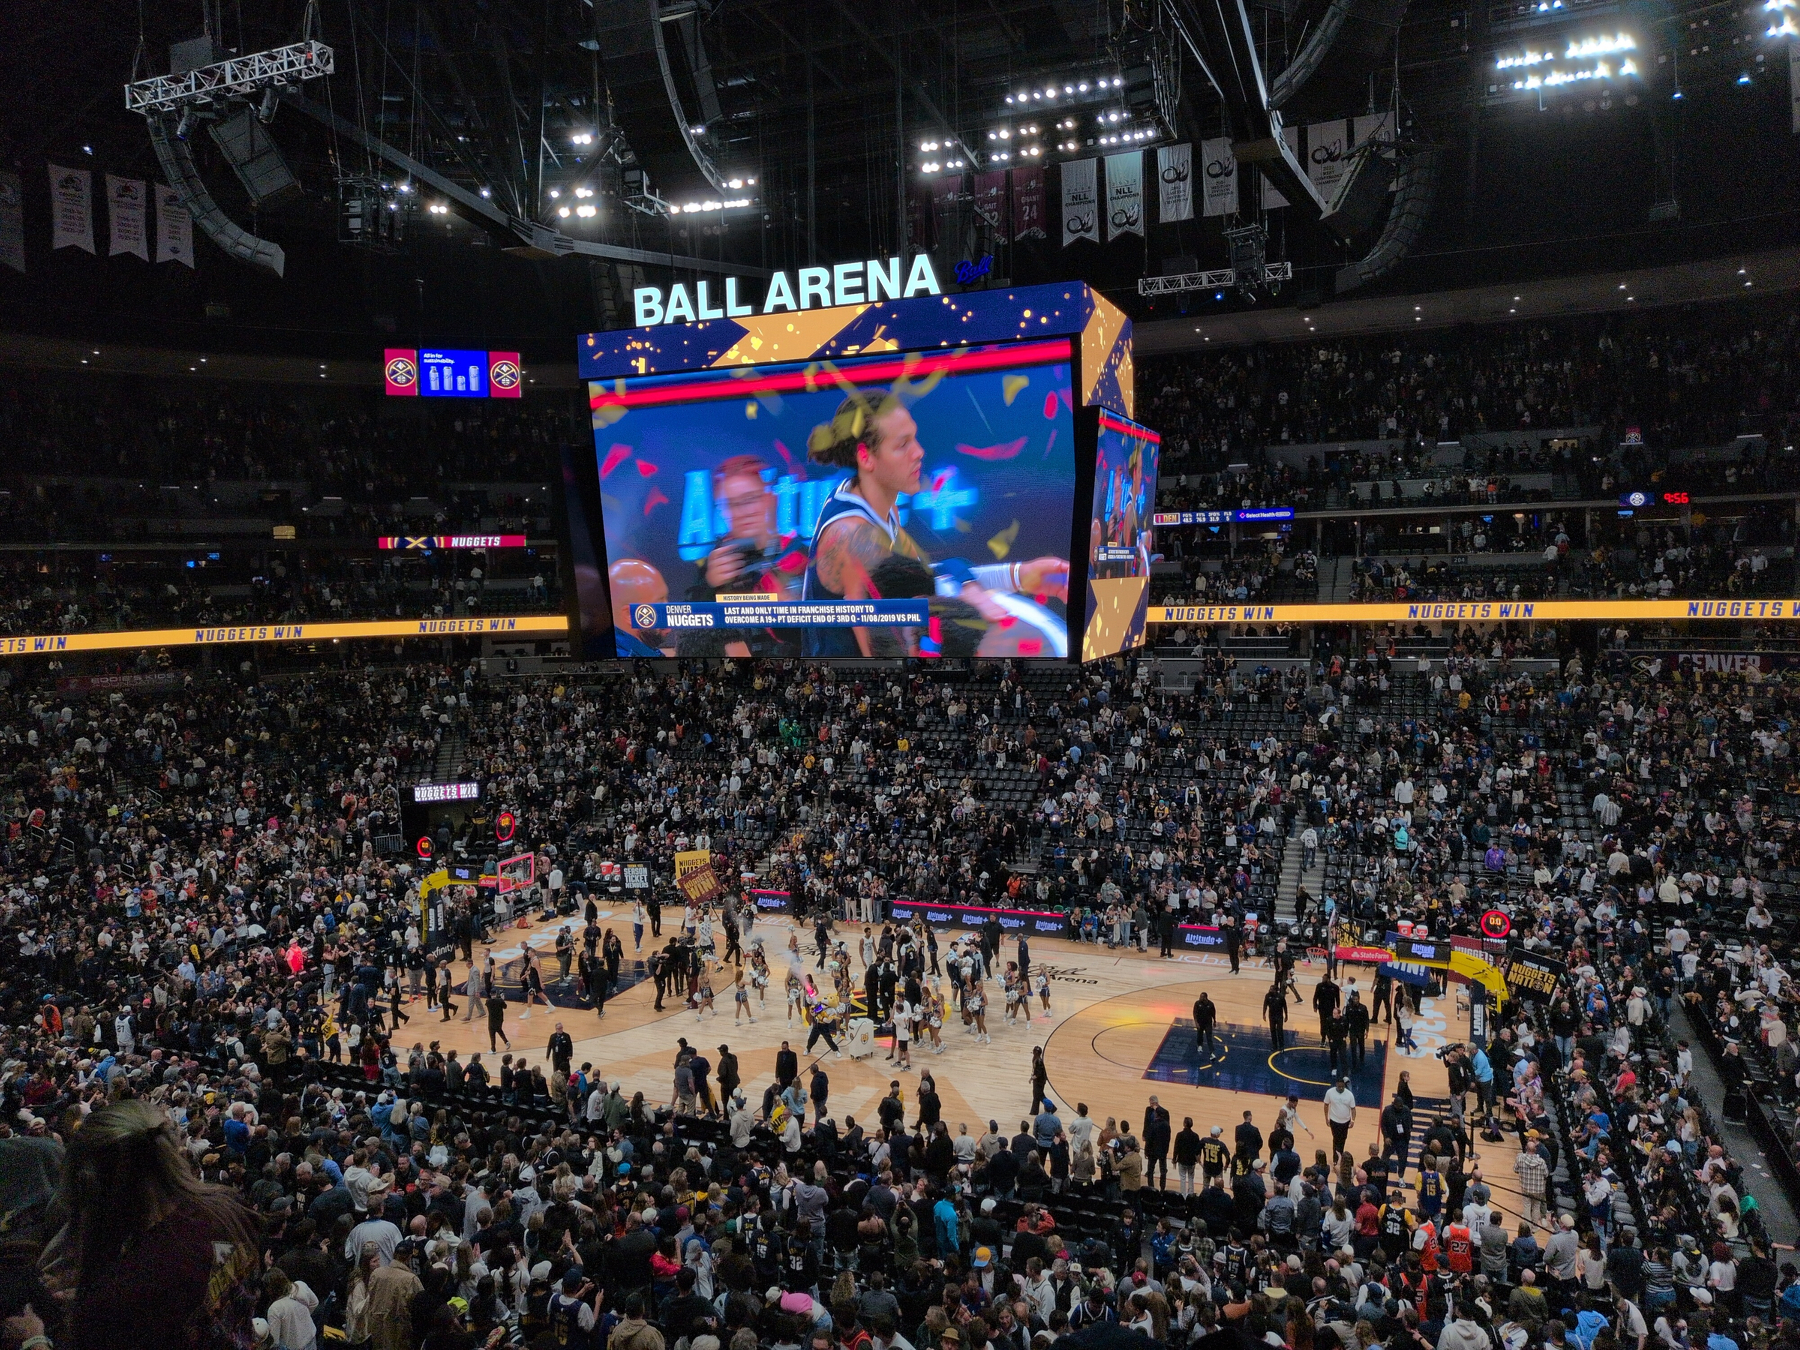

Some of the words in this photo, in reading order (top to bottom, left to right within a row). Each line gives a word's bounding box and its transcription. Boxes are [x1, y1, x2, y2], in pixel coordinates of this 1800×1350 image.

[1115, 187, 1133, 195] NLL
[953, 254, 994, 285] Ball
[633, 277, 752, 327] BALL
[762, 253, 941, 313] ARENA
[1663, 492, 1689, 504] 9:56
[1163, 513, 1177, 523] DEN
[451, 536, 500, 547] NUGGETS
[666, 605, 692, 614] DENVER
[724, 606, 740, 615] LAST
[741, 606, 754, 614] AND
[755, 606, 772, 614] ONLY
[772, 606, 789, 614] TIME
[790, 606, 797, 614] IN
[798, 606, 835, 614] FRANCHISE
[836, 605, 864, 613] HISTORY
[865, 605, 874, 613] TO
[1165, 607, 1236, 620] NUGGETS
[1243, 607, 1274, 620] WIN
[1408, 604, 1491, 618] NUGGETS
[1500, 603, 1534, 618] WIN
[1687, 602, 1783, 616] NUGGETS
[419, 618, 484, 633] NUGGETS
[490, 618, 516, 631] WIN
[667, 614, 714, 627] NUGGETS
[724, 616, 760, 624] OVERCOME
[765, 615, 777, 623] 19+
[778, 615, 786, 623] PT
[787, 615, 811, 623] DEFICIT
[836, 614, 850, 622] 3RD
[851, 614, 856, 622] Q
[861, 614, 896, 622] 11/08/2019
[896, 614, 905, 622] VS
[906, 614, 921, 622] PHL
[195, 627, 268, 642] NUGGETS
[274, 625, 303, 638] WIN
[34, 636, 67, 650] WIN
[415, 788, 458, 799] NUGGETS
[460, 786, 478, 796] WIN
[679, 858, 706, 866] NUGGETS
[686, 876, 717, 900] WIN!
[926, 910, 953, 922] Altitude+
[962, 914, 988, 925] Altitude+
[1035, 920, 1063, 932] Altitude+
[1185, 933, 1224, 946] Altitude+
[431, 942, 454, 958] xfinity
[1374, 952, 1390, 960] Farm
[1511, 962, 1556, 984] NUGGETS
[1474, 1004, 1484, 1036] UMB
[1205, 1149, 1218, 1163] 15
[1426, 1184, 1436, 1196] 15
[1386, 1221, 1400, 1236] 32
[757, 1244, 768, 1258] 15
[1452, 1242, 1468, 1254] 27
[789, 1255, 803, 1270] 32
